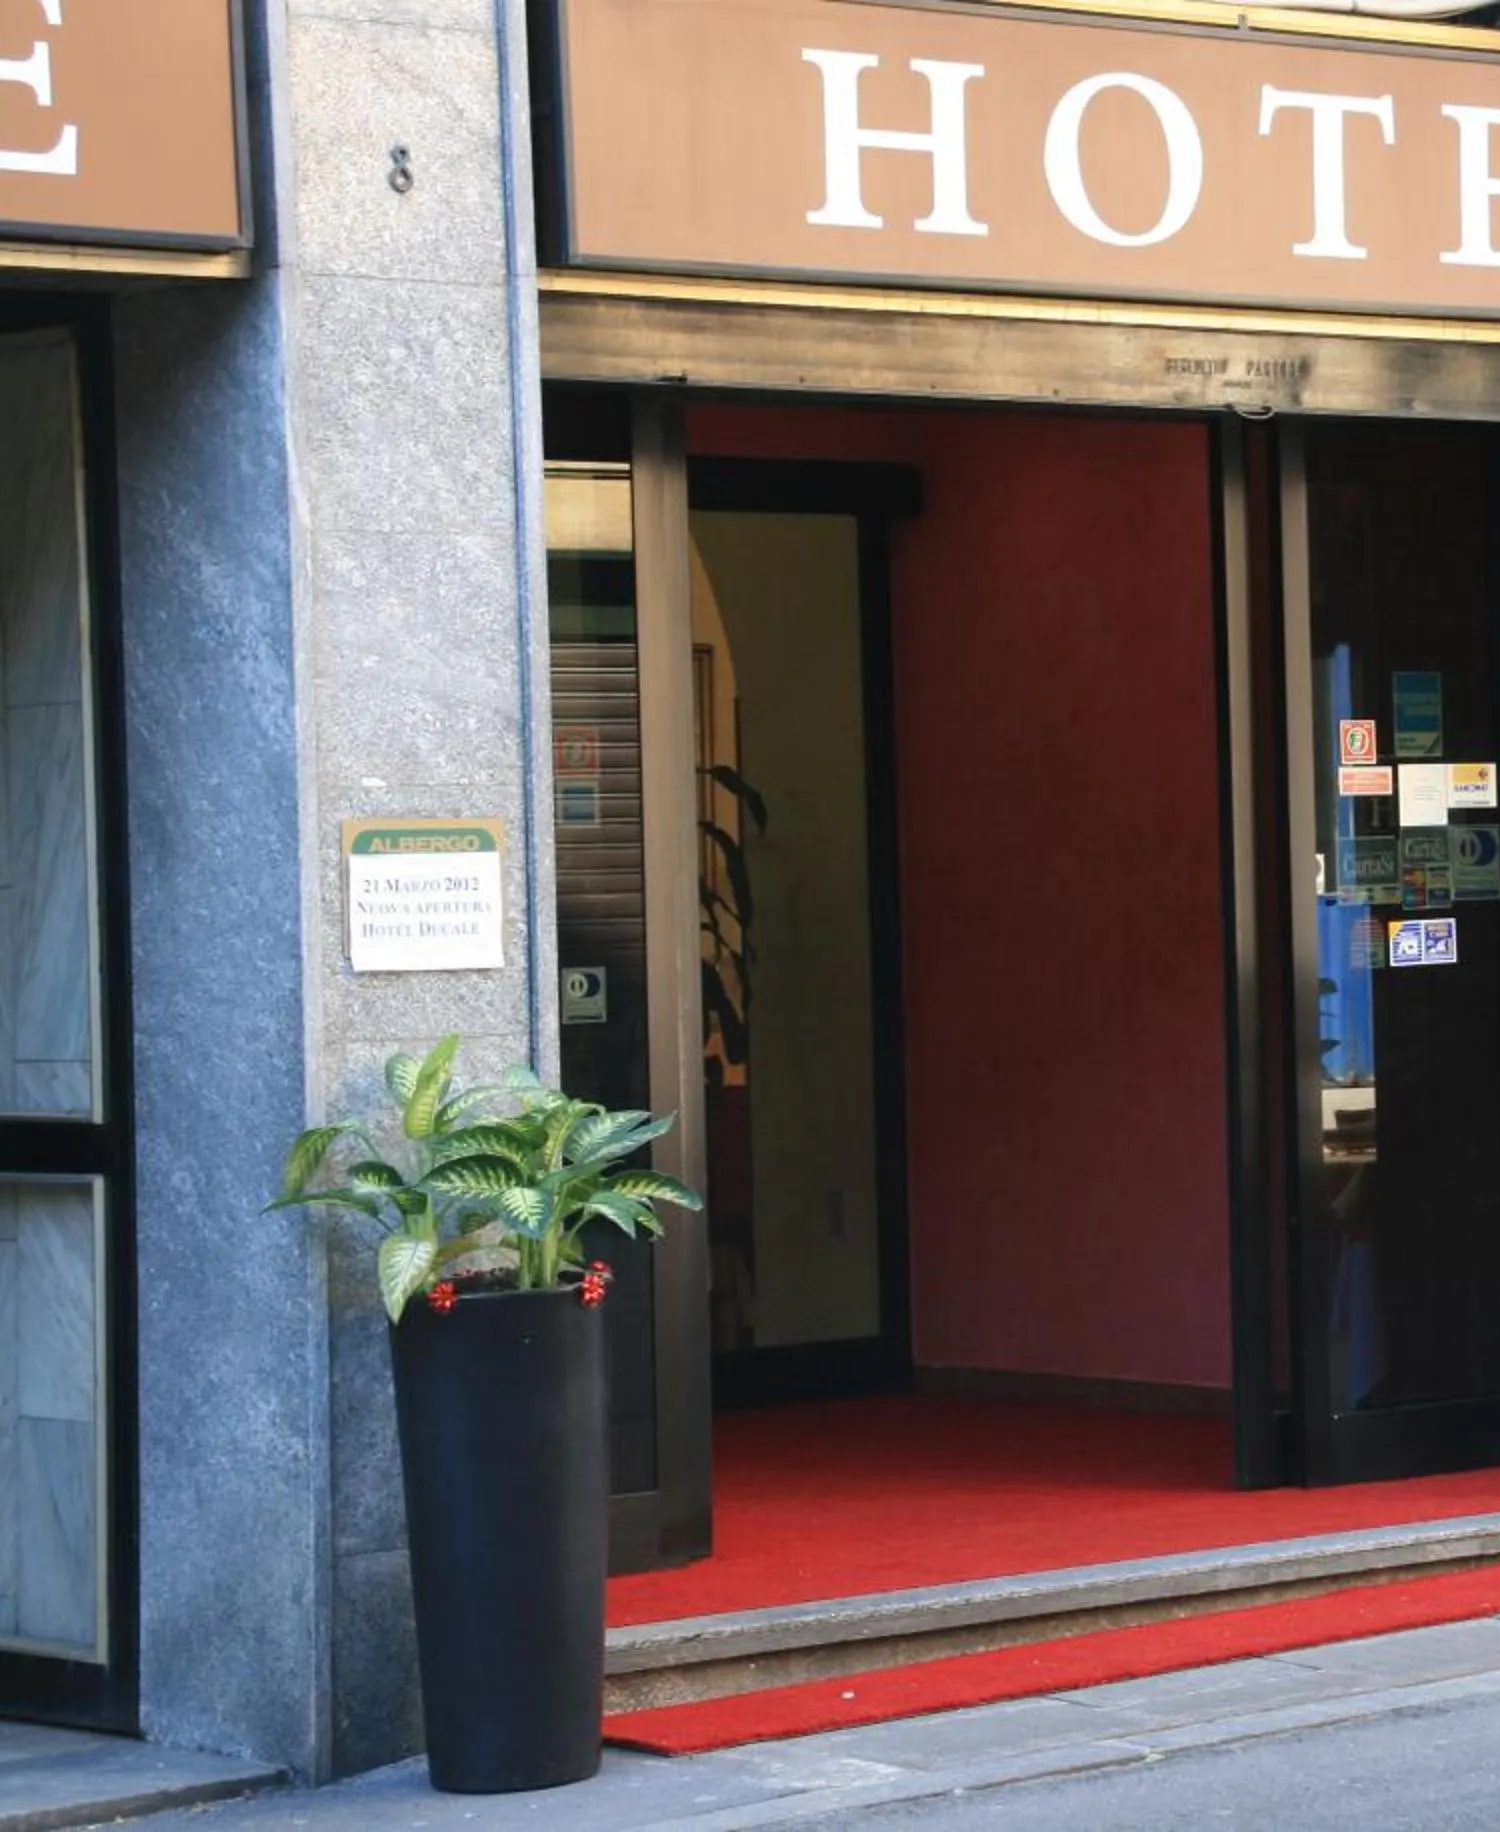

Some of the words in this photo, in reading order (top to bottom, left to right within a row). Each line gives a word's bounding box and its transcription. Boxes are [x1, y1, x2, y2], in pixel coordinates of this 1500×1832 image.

[388, 145, 413, 193] 8
[368, 834, 480, 853] ALBERGO
[363, 878, 380, 893] 21
[384, 877, 440, 893] MARZO
[444, 876, 480, 892] 2012
[362, 922, 414, 938] HOTEL
[418, 921, 480, 938] DUCALE
